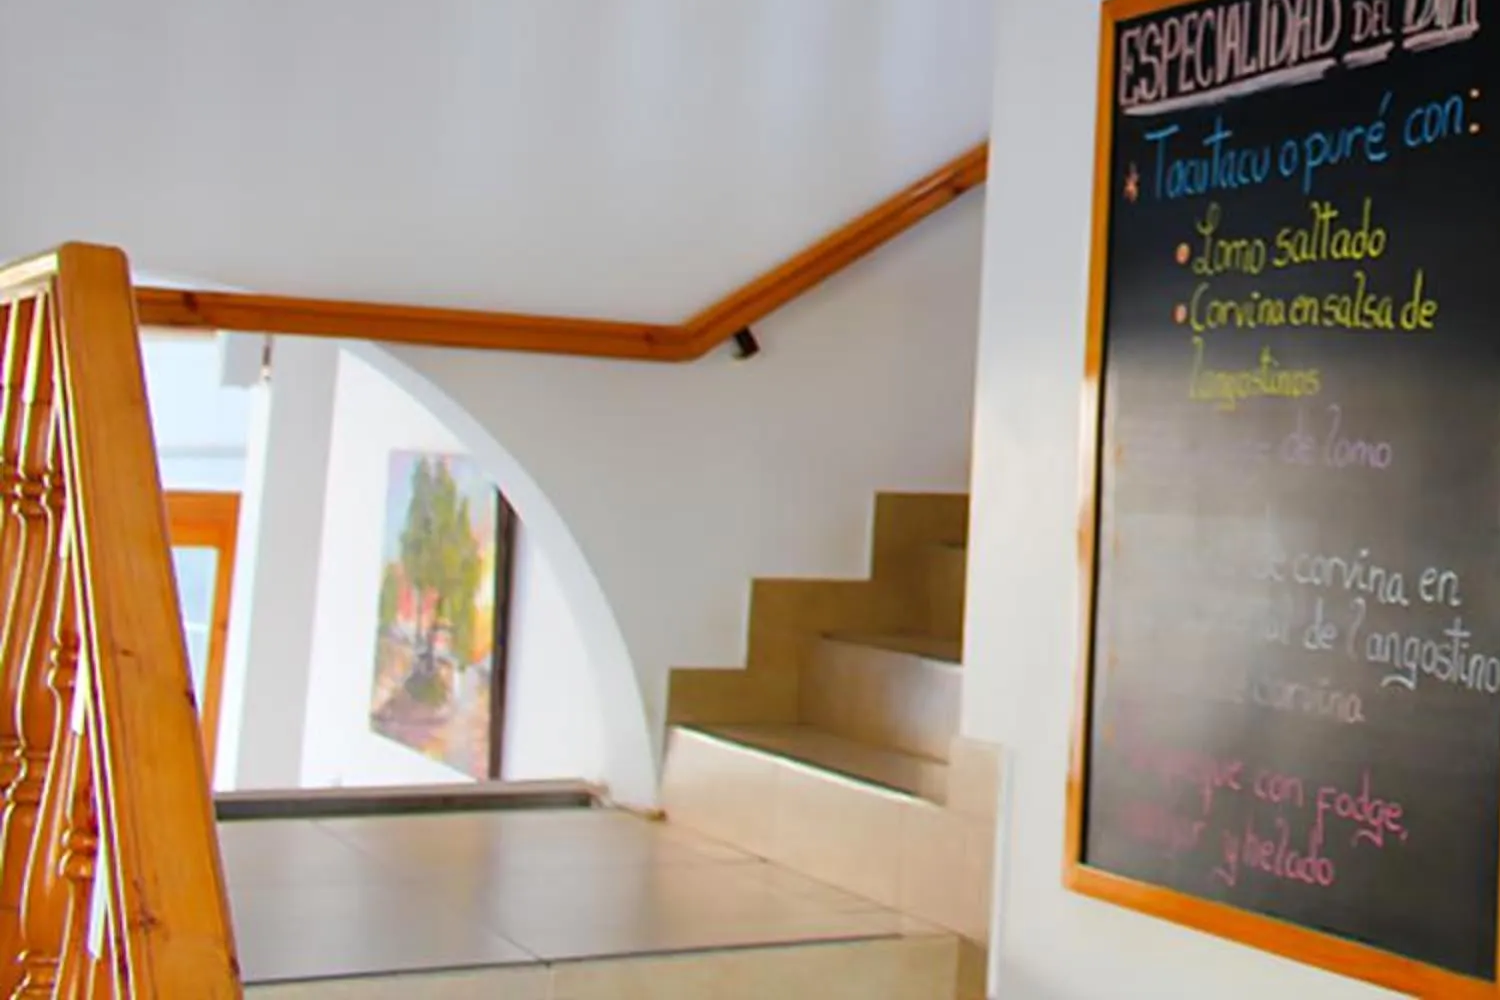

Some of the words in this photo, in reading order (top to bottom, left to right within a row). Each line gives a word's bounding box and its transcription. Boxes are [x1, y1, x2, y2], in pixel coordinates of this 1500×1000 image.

[1303, 91, 1393, 195] puré
[1192, 202, 1267, 277] Lomo
[1272, 198, 1387, 269] saltado
[1189, 282, 1287, 332] Corvina
[1289, 295, 1320, 328] en
[1324, 270, 1395, 331] salsa
[1400, 268, 1440, 331] de
[1293, 548, 1411, 608] corvina
[1418, 565, 1462, 608] en
[1303, 597, 1339, 650] de
[1252, 772, 1305, 809] con
[1242, 811, 1335, 886] helado
